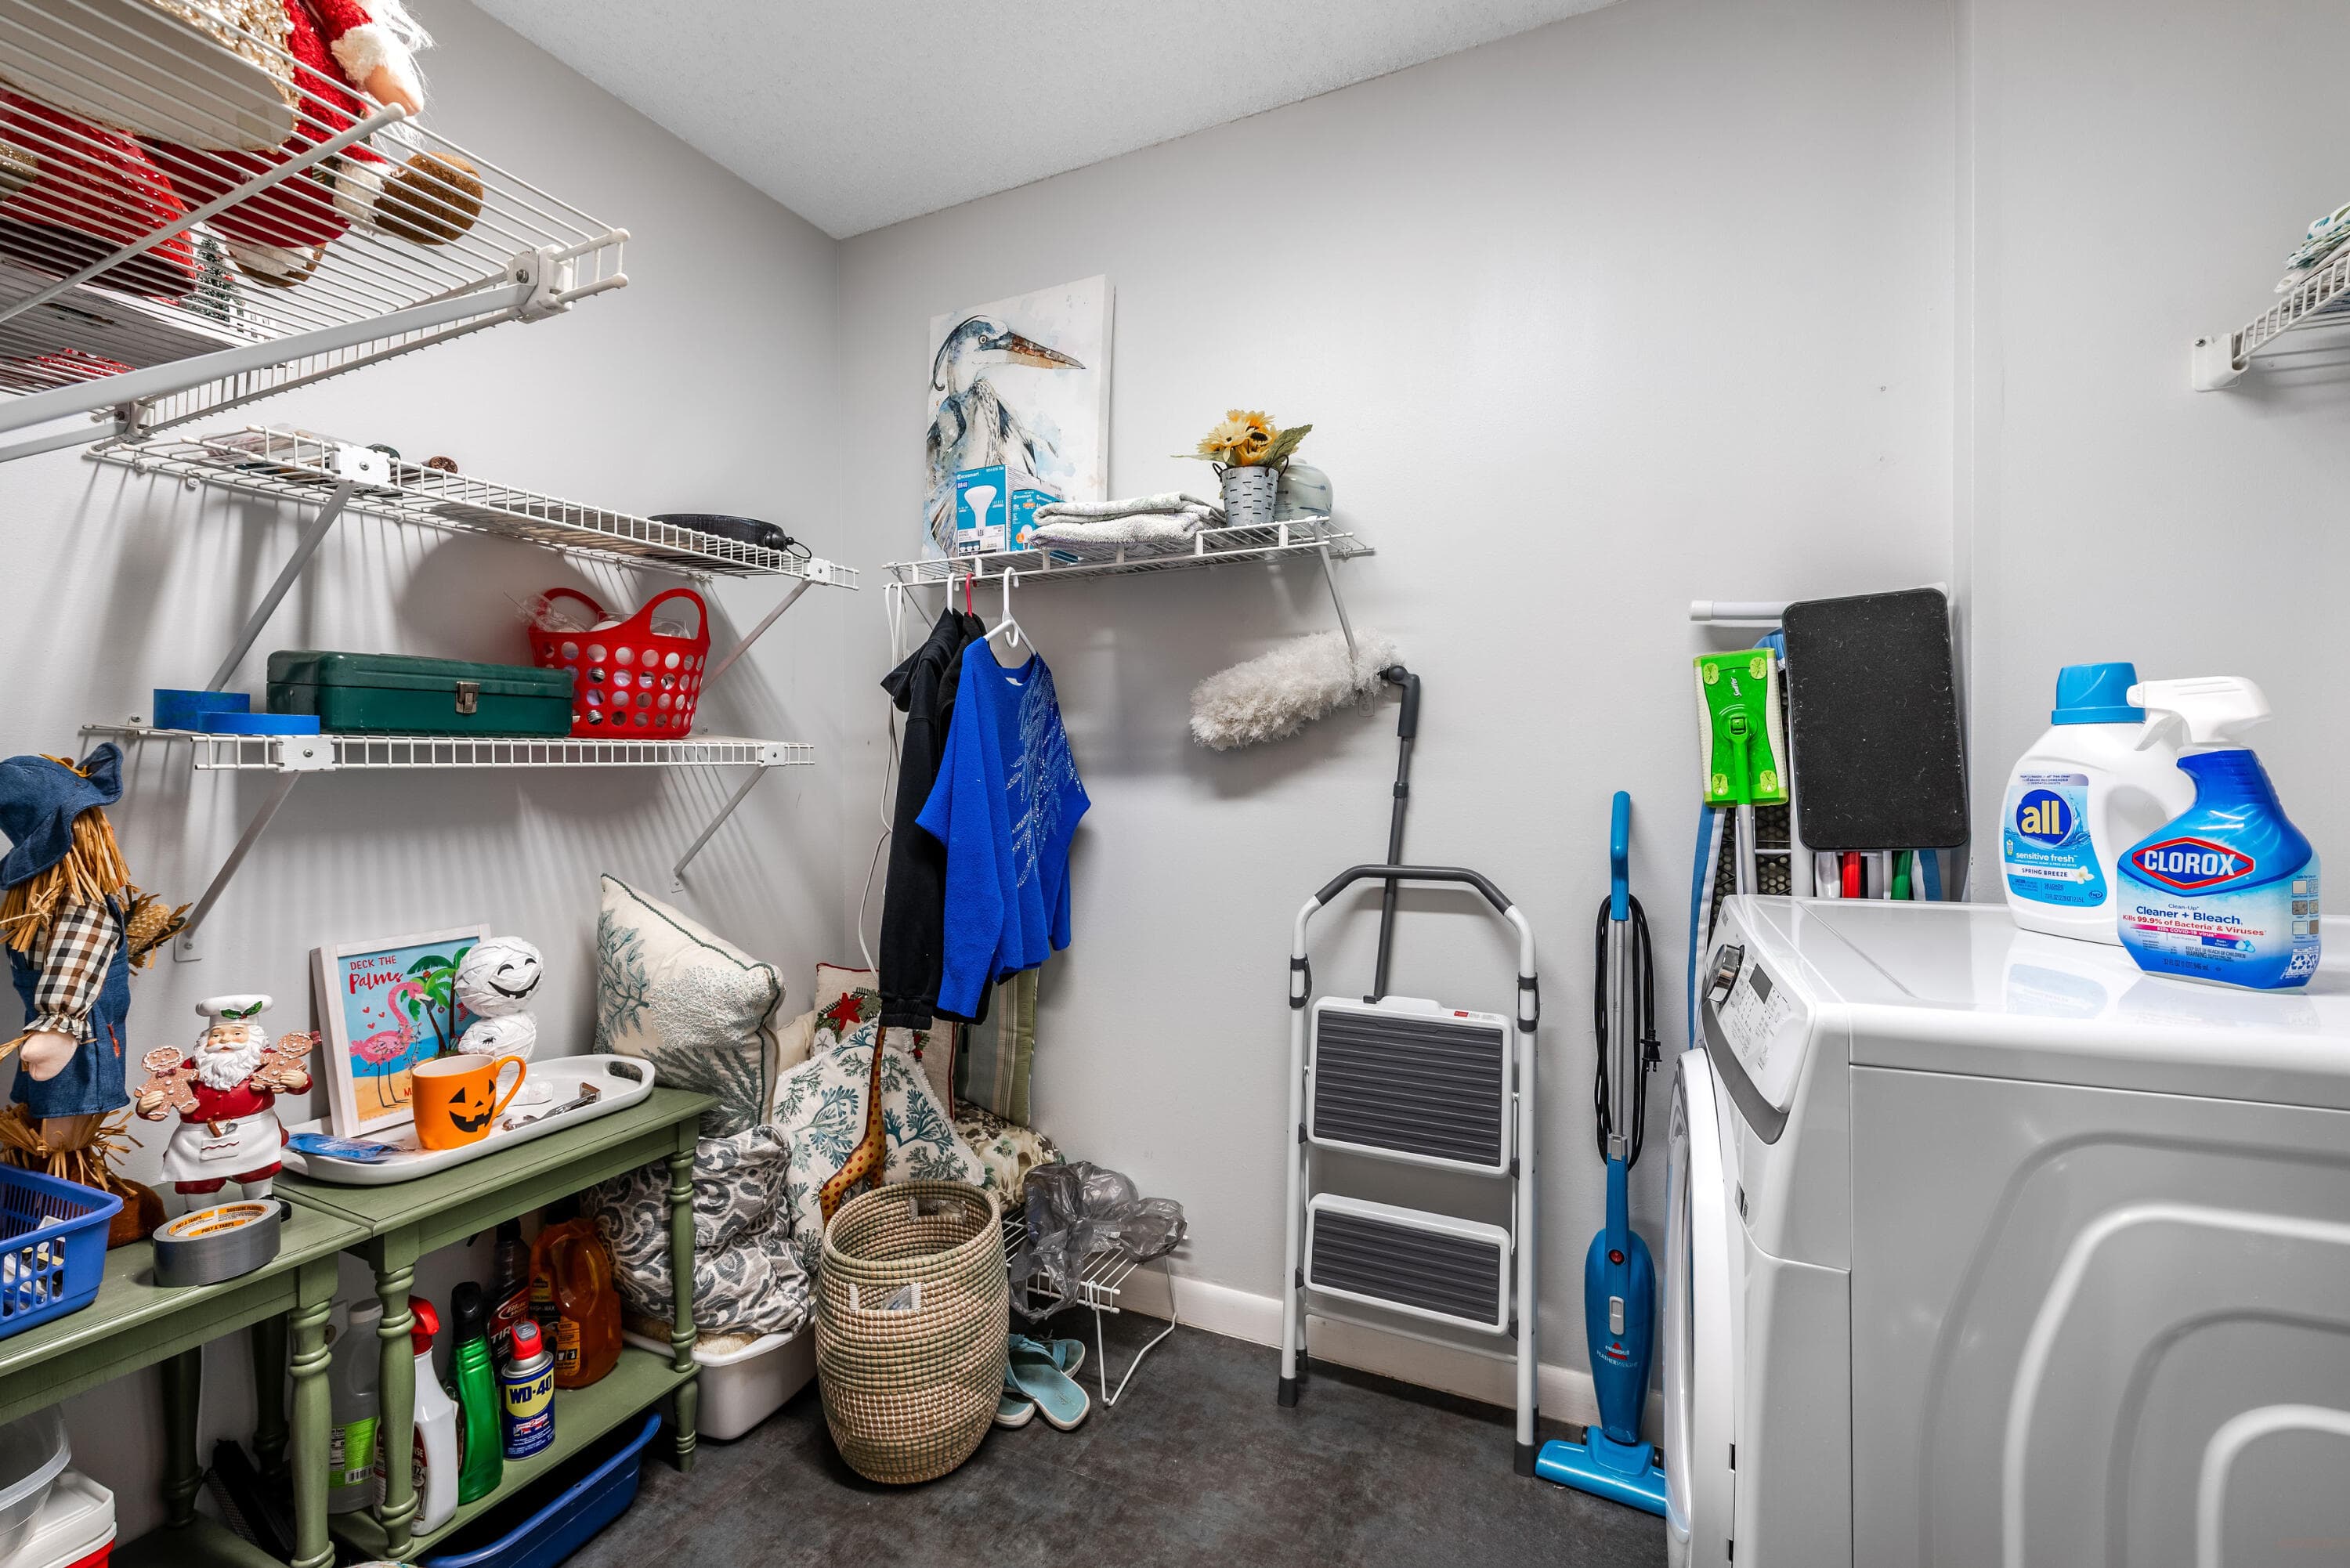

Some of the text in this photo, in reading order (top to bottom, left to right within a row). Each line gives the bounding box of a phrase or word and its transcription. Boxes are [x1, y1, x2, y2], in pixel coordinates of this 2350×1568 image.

[2021, 800, 2061, 835] all
[2016, 852, 2050, 862] sensitive
[2144, 850, 2236, 876] CLOROX
[2136, 906, 2178, 918] Cleaner
[349, 955, 397, 970] DECK THE
[349, 971, 403, 995] Palms
[187, 1215, 203, 1223] TARPS
[509, 1375, 552, 1404] WD-40
